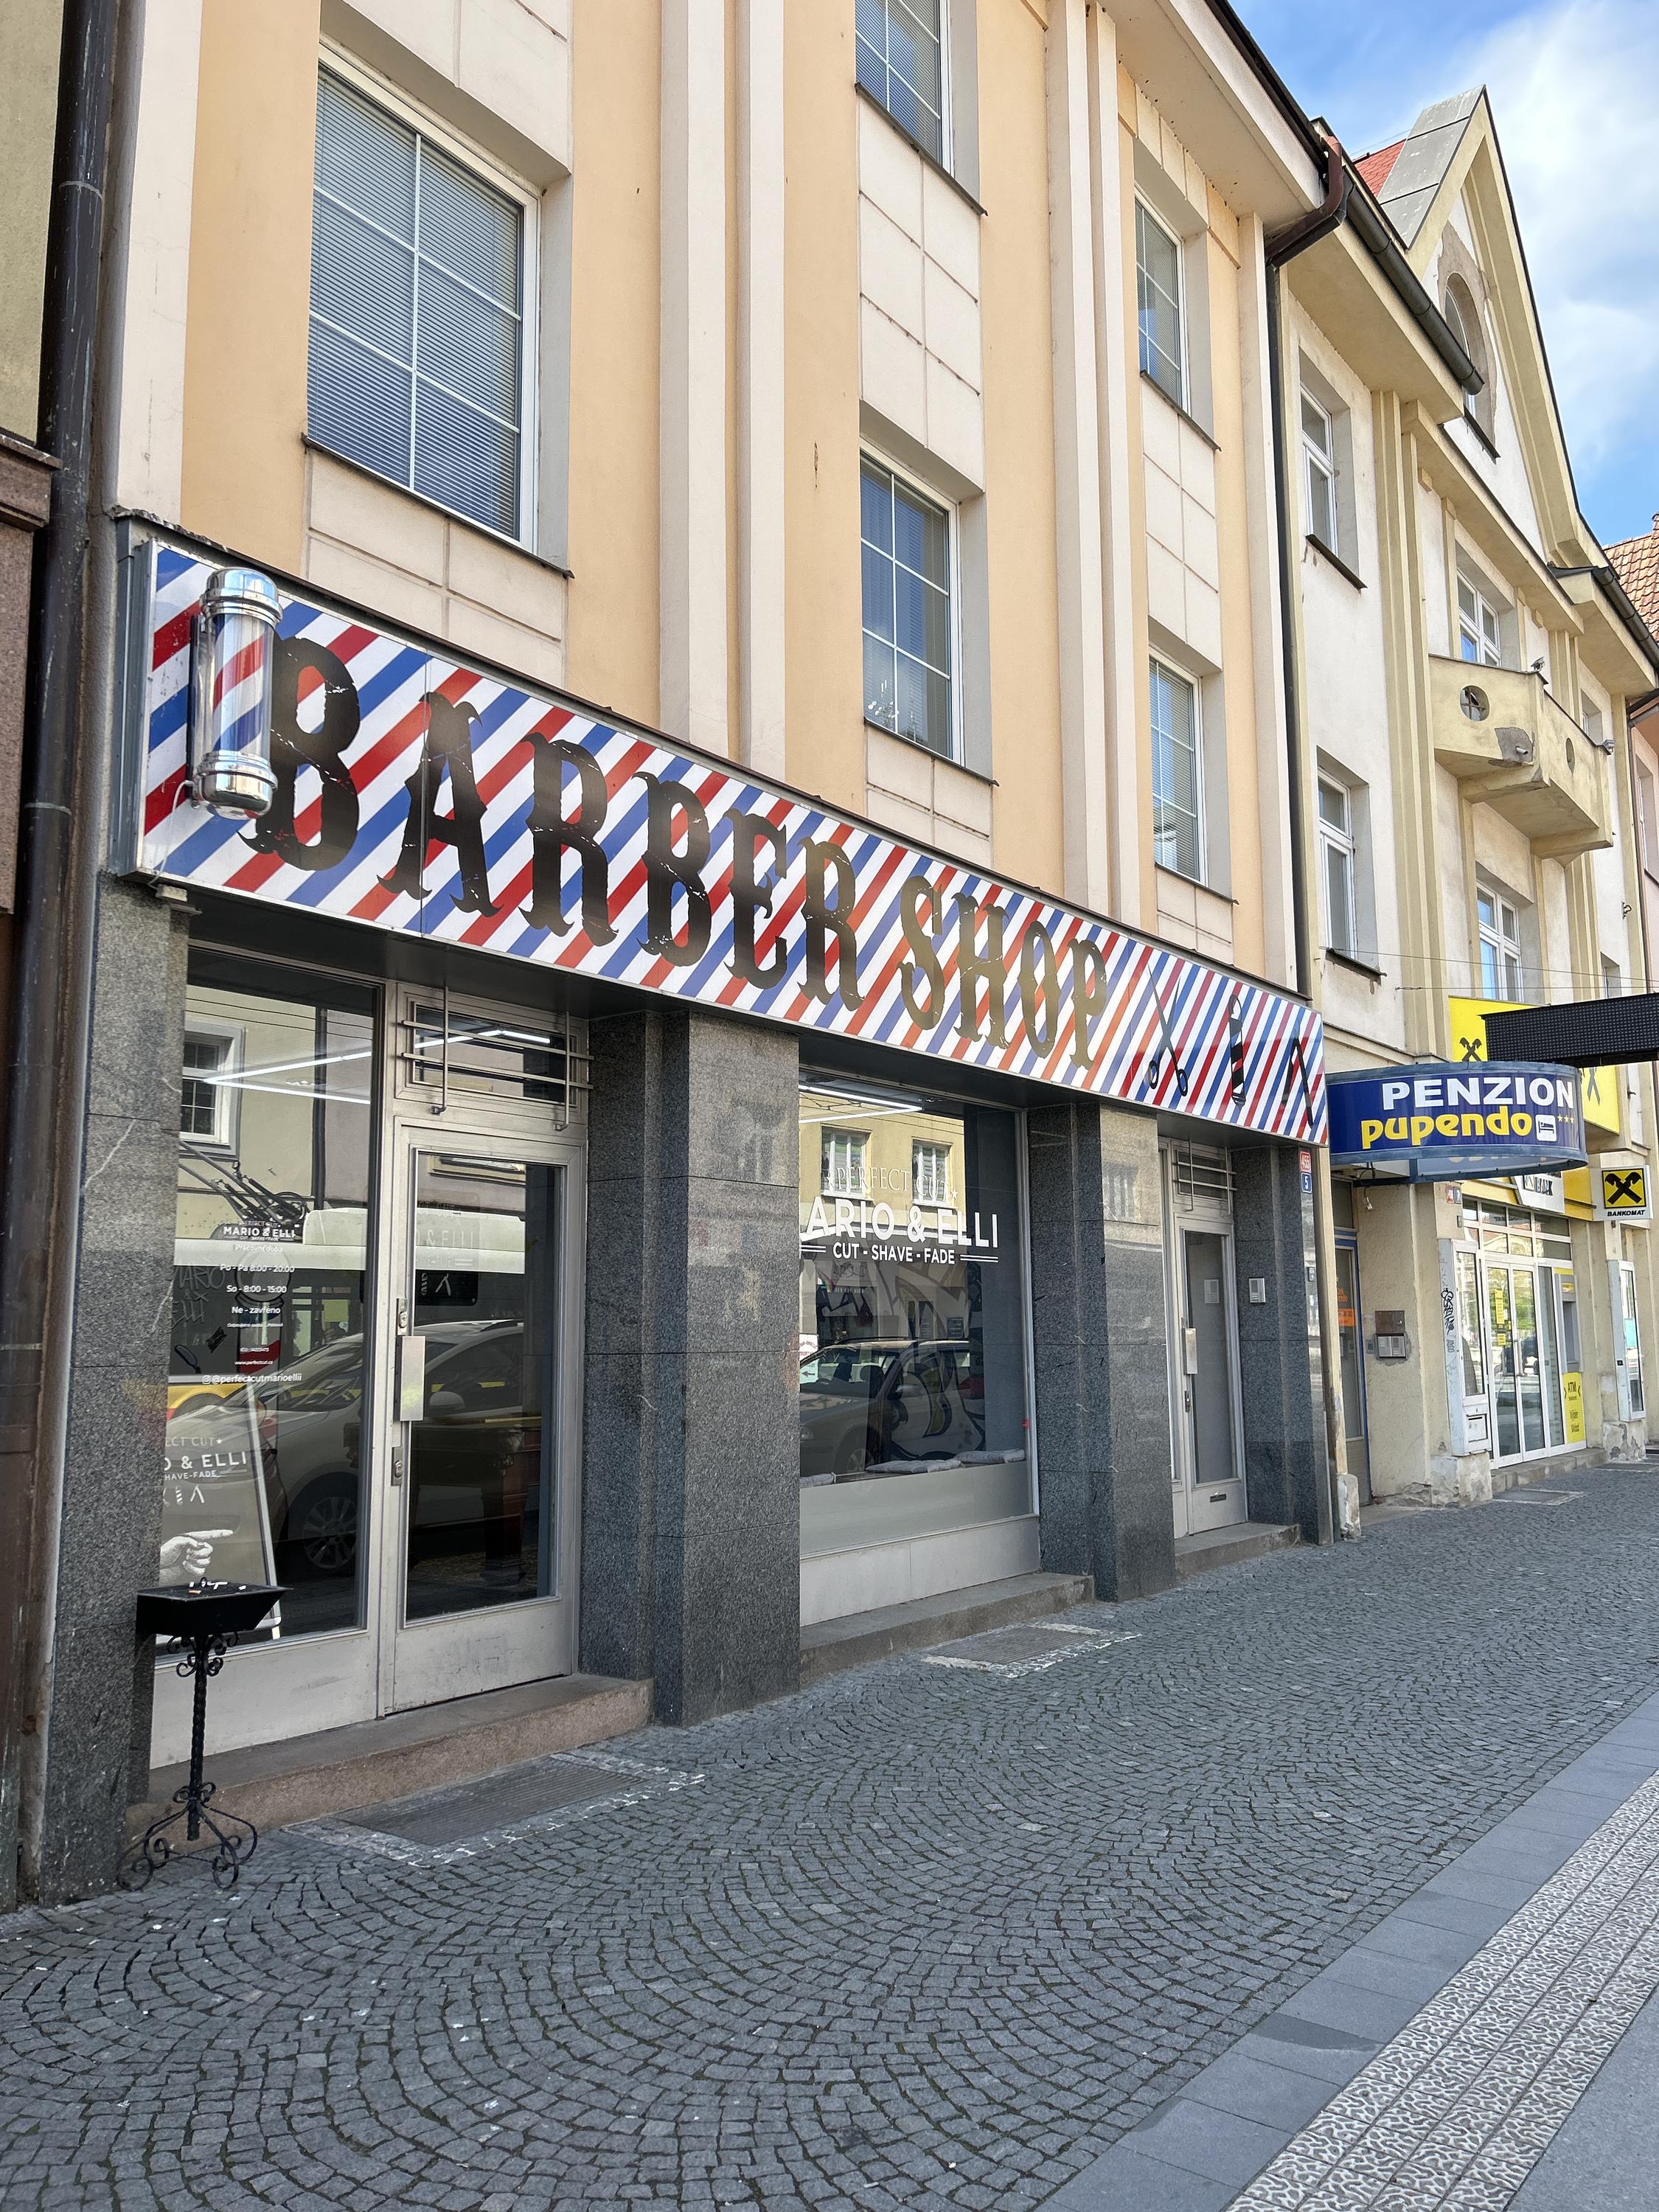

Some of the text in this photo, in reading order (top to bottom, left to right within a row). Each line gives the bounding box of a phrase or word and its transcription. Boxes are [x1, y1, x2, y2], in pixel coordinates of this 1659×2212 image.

[237, 637, 1107, 1070] BARBER SHOP
[1382, 1077, 1574, 1110] PENZION
[1361, 1106, 1533, 1150] pupendo
[836, 1167, 950, 1203] PERFECT CUT
[1304, 1175, 1309, 1190] 5
[1535, 1177, 1554, 1196] BANK
[806, 1196, 998, 1248] ARIO & ELLI
[1607, 1209, 1646, 1217] BANKOMAT
[223, 1226, 296, 1238] MARIO & ELLI
[832, 1242, 860, 1259] CUT
[871, 1244, 914, 1262] SHAVE
[924, 1248, 956, 1265] FADE
[226, 1285, 237, 1293] So
[243, 1285, 261, 1293] 8:00
[267, 1285, 288, 1294] 15:00
[232, 1307, 243, 1315] Ne
[1568, 1381, 1577, 1393] ATM
[165, 1436, 215, 1447] ECT CUT
[181, 1455, 193, 1470] &
[201, 1451, 247, 1468] ELLI
